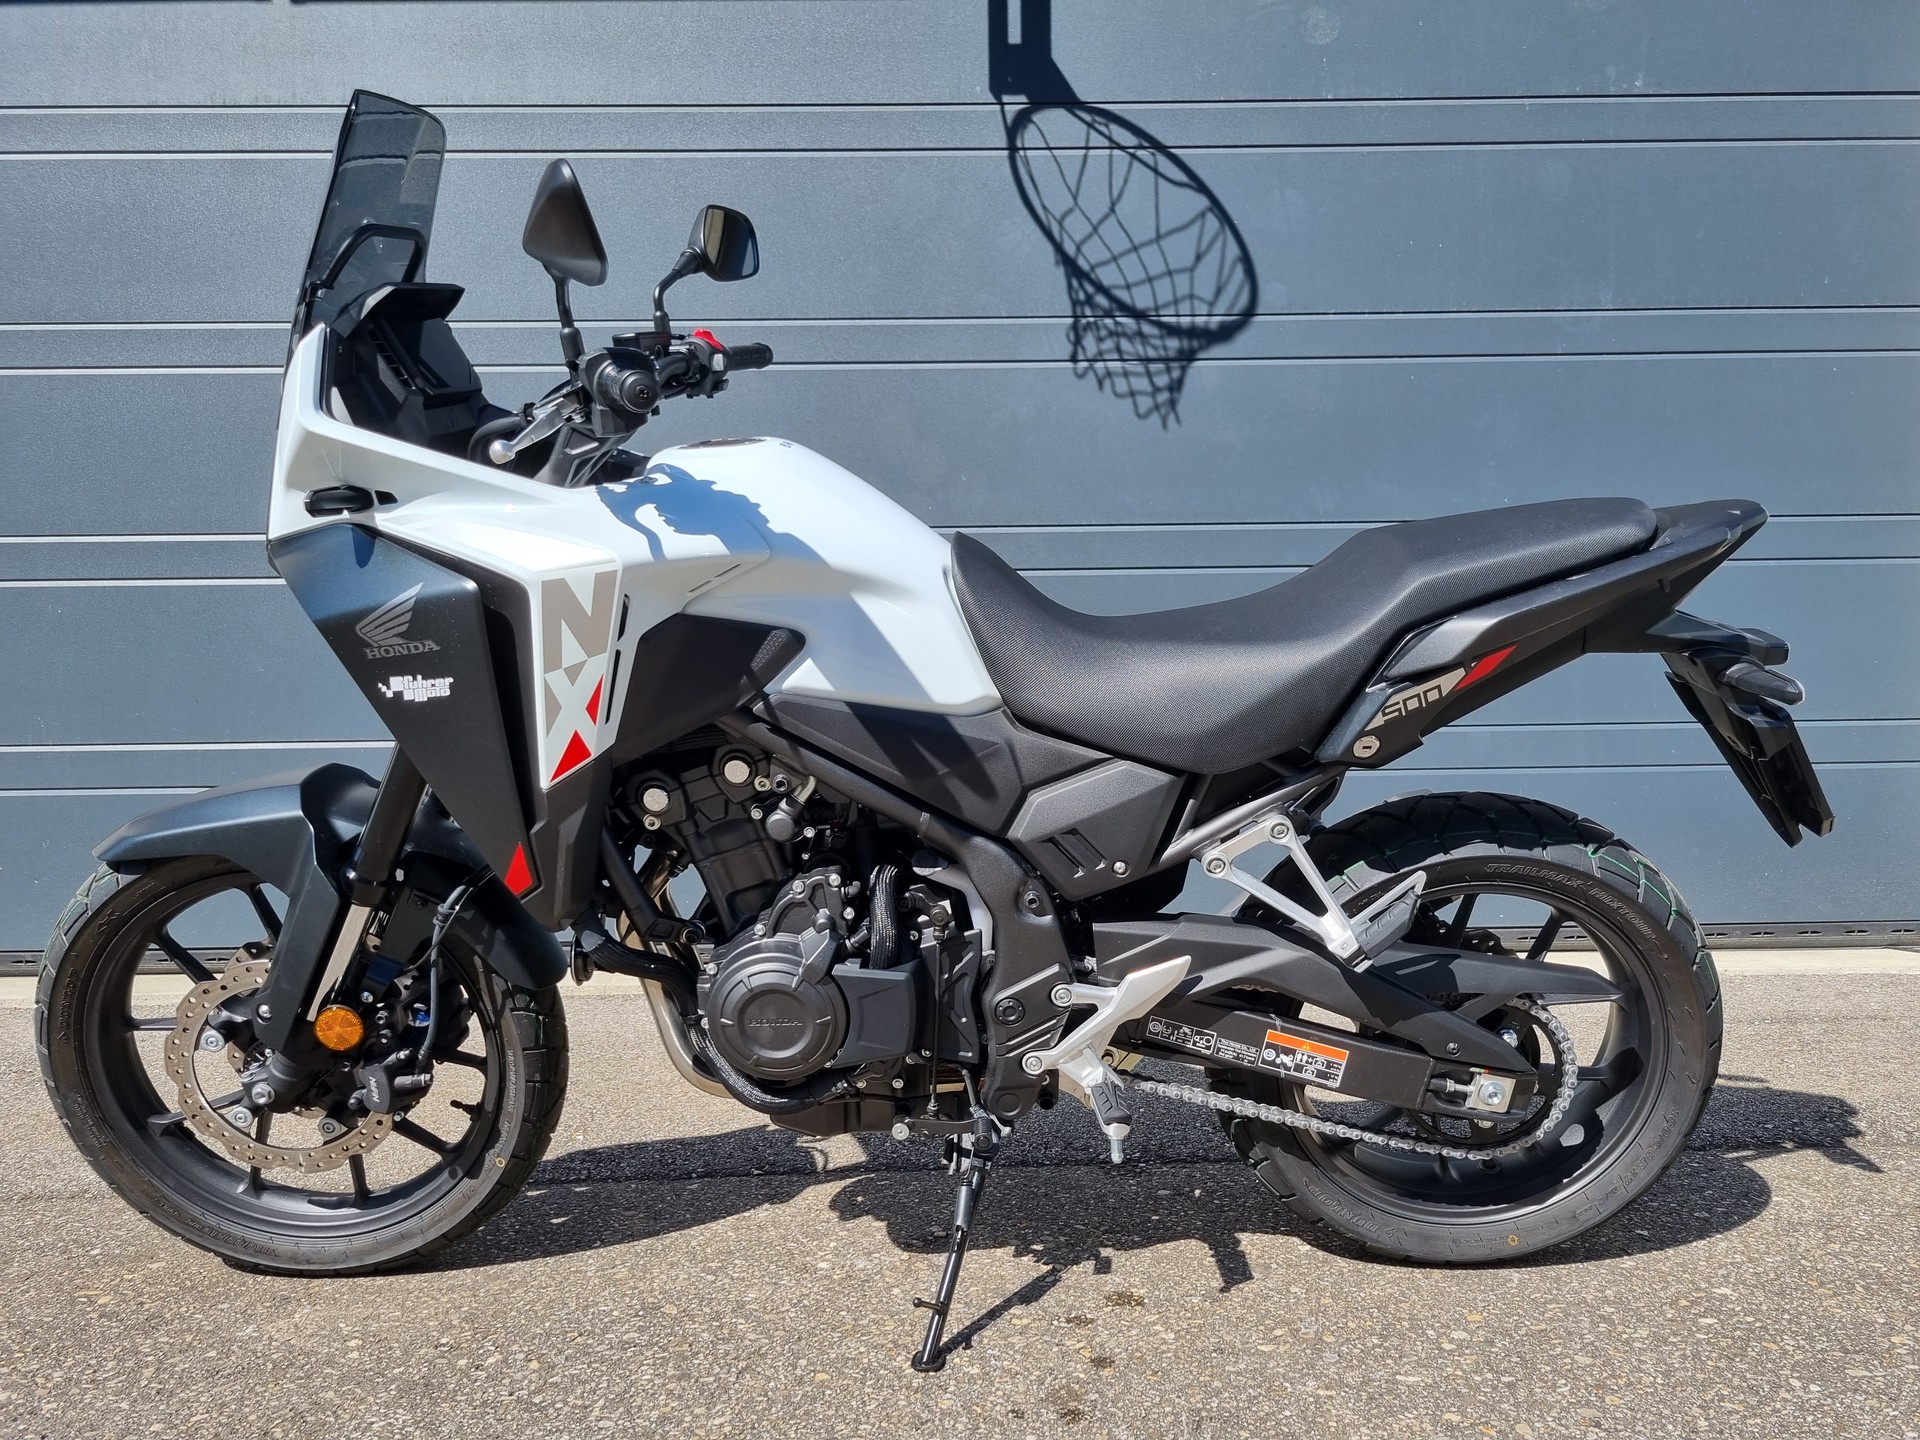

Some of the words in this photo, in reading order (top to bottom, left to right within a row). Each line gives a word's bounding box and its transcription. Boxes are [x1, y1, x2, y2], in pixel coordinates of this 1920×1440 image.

[364, 640, 440, 660] HONDA
[541, 569, 618, 783] NX
[747, 1017, 803, 1027] HONDA
[1307, 1186, 1382, 1233] DUNLOP
